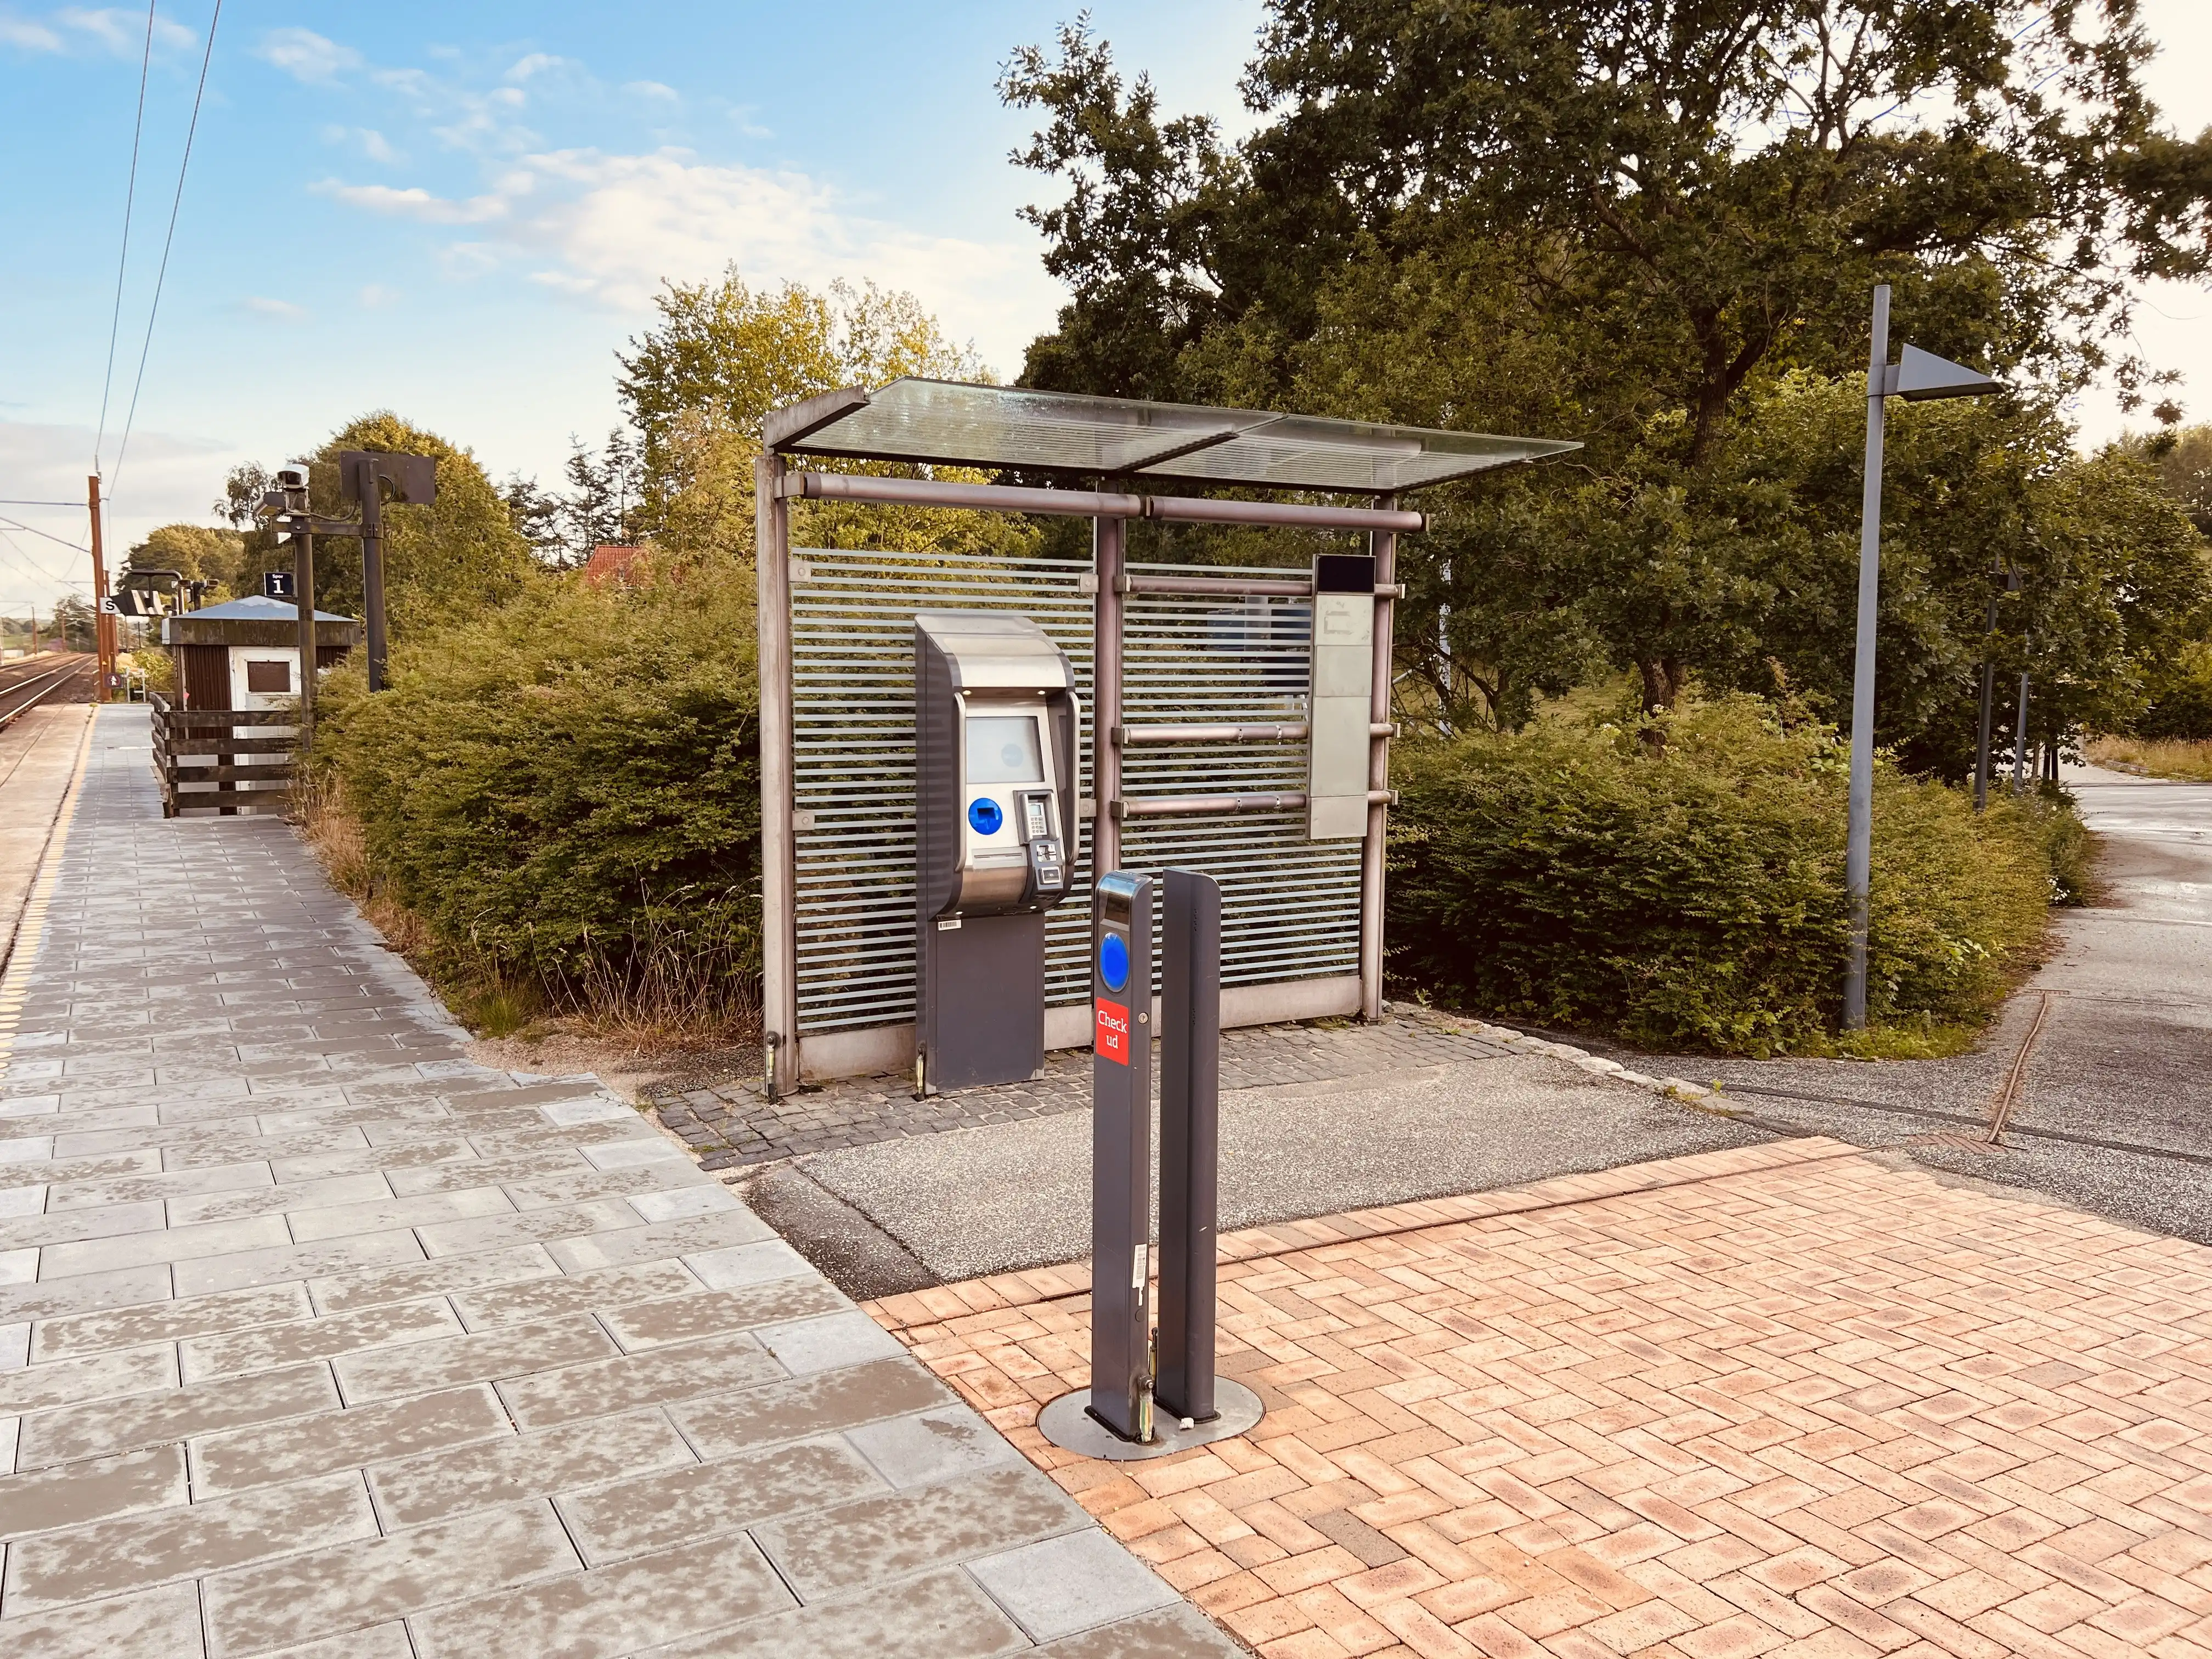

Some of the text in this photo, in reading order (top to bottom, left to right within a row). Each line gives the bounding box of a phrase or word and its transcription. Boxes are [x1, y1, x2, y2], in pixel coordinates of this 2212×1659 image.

[273, 579, 284, 594] 1
[105, 601, 115, 610] S
[1098, 1010, 1127, 1034] Check
[1106, 1034, 1119, 1049] ud
